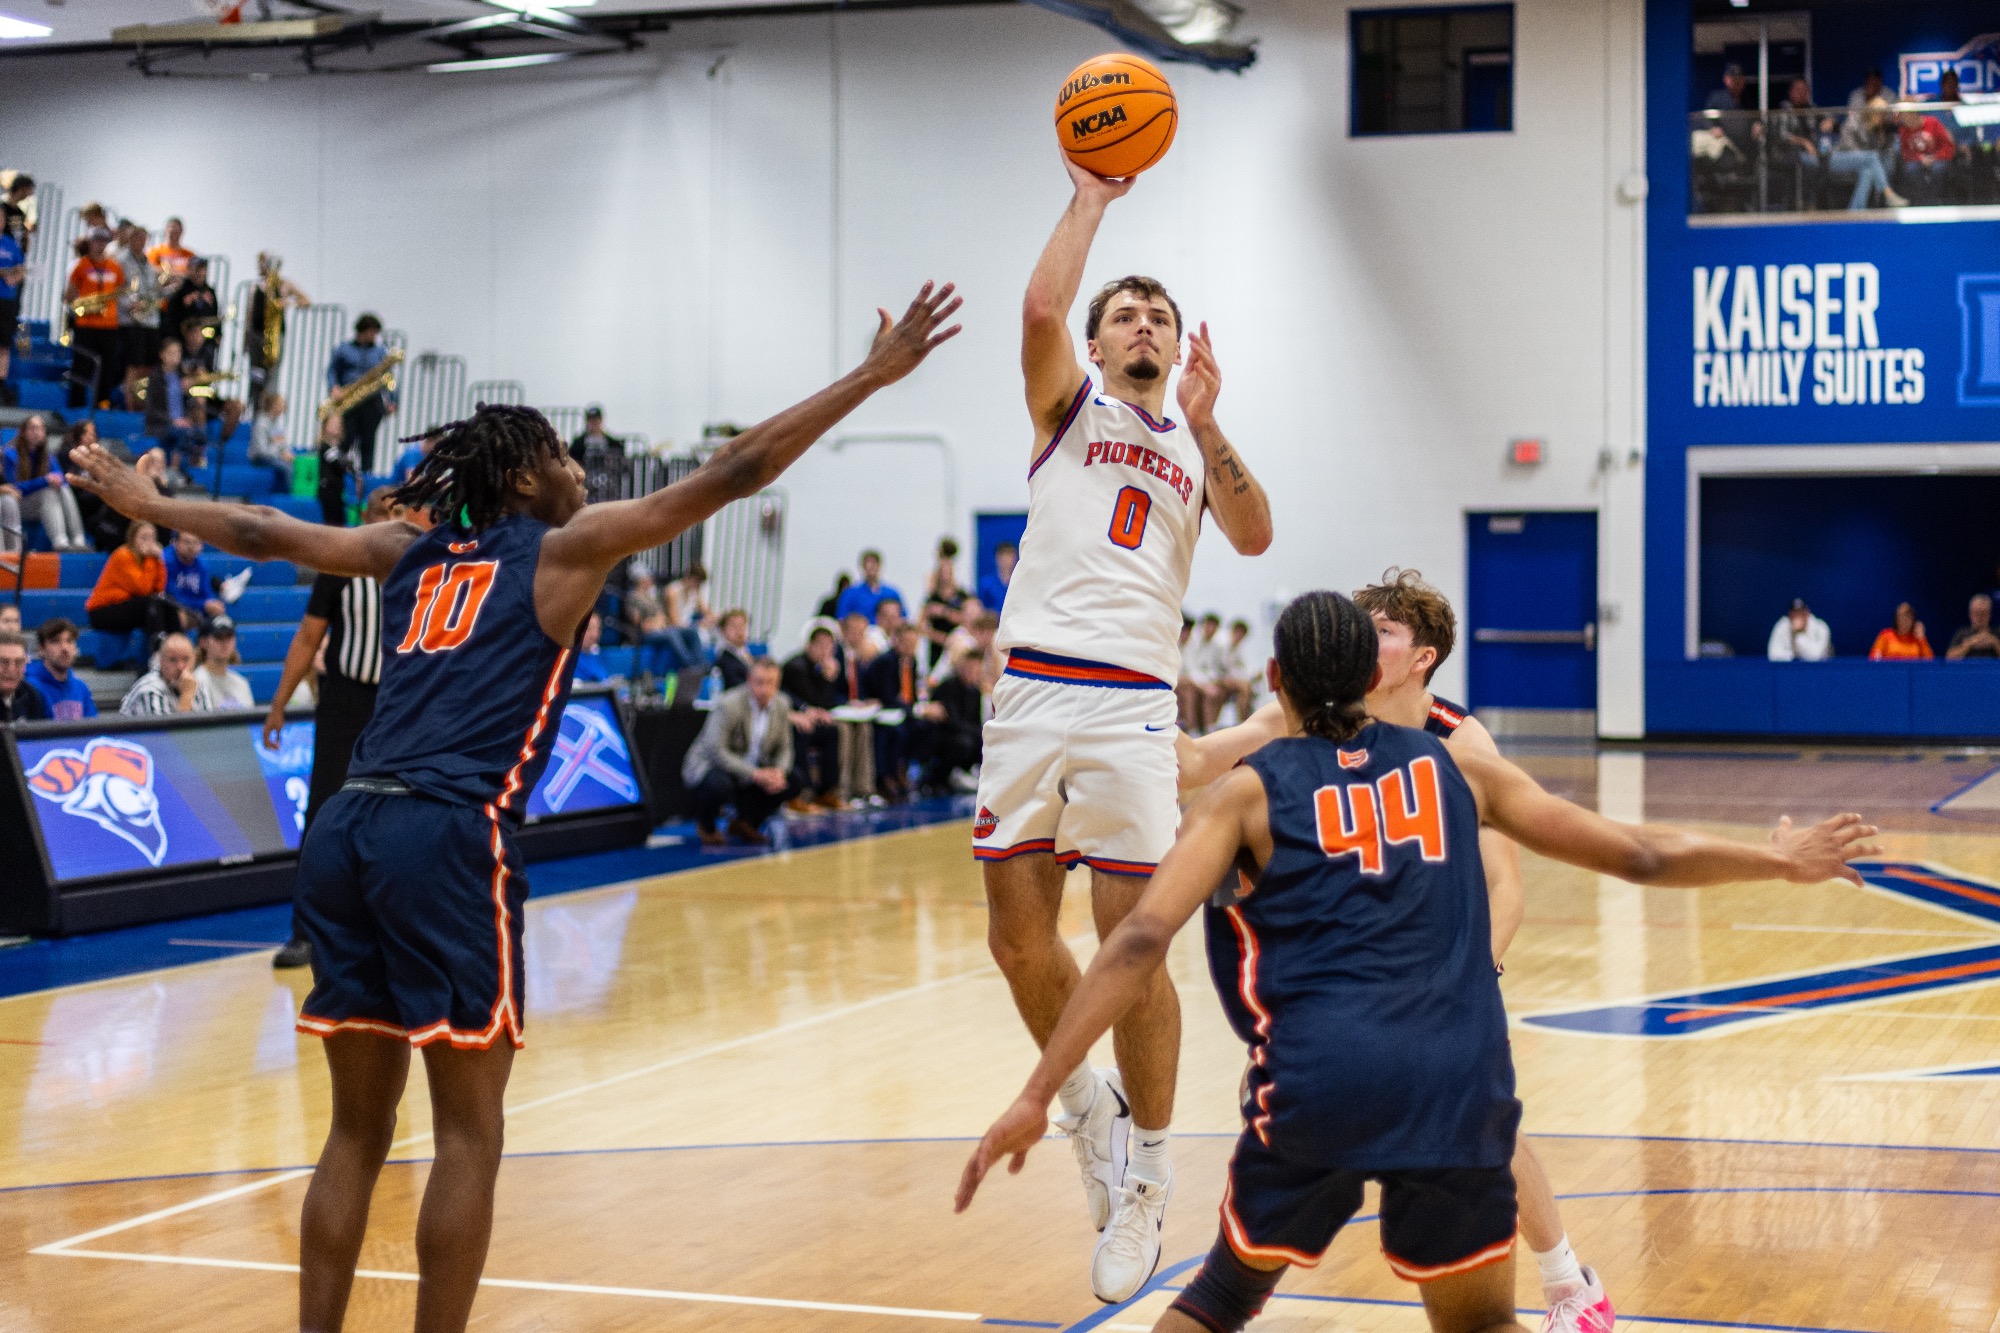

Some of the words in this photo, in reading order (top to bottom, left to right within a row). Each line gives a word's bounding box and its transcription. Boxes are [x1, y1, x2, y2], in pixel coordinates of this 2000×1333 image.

[1058, 72, 1131, 107] Wilson
[1071, 104, 1128, 139] NCAA
[1693, 262, 1880, 351] KAISER
[1693, 350, 1806, 408] FAMILY
[1813, 348, 1925, 405] SUITES
[1083, 440, 1194, 506] PIONEERS
[1108, 484, 1153, 551] 0
[396, 559, 500, 655] 10
[1313, 755, 1446, 875] 44
